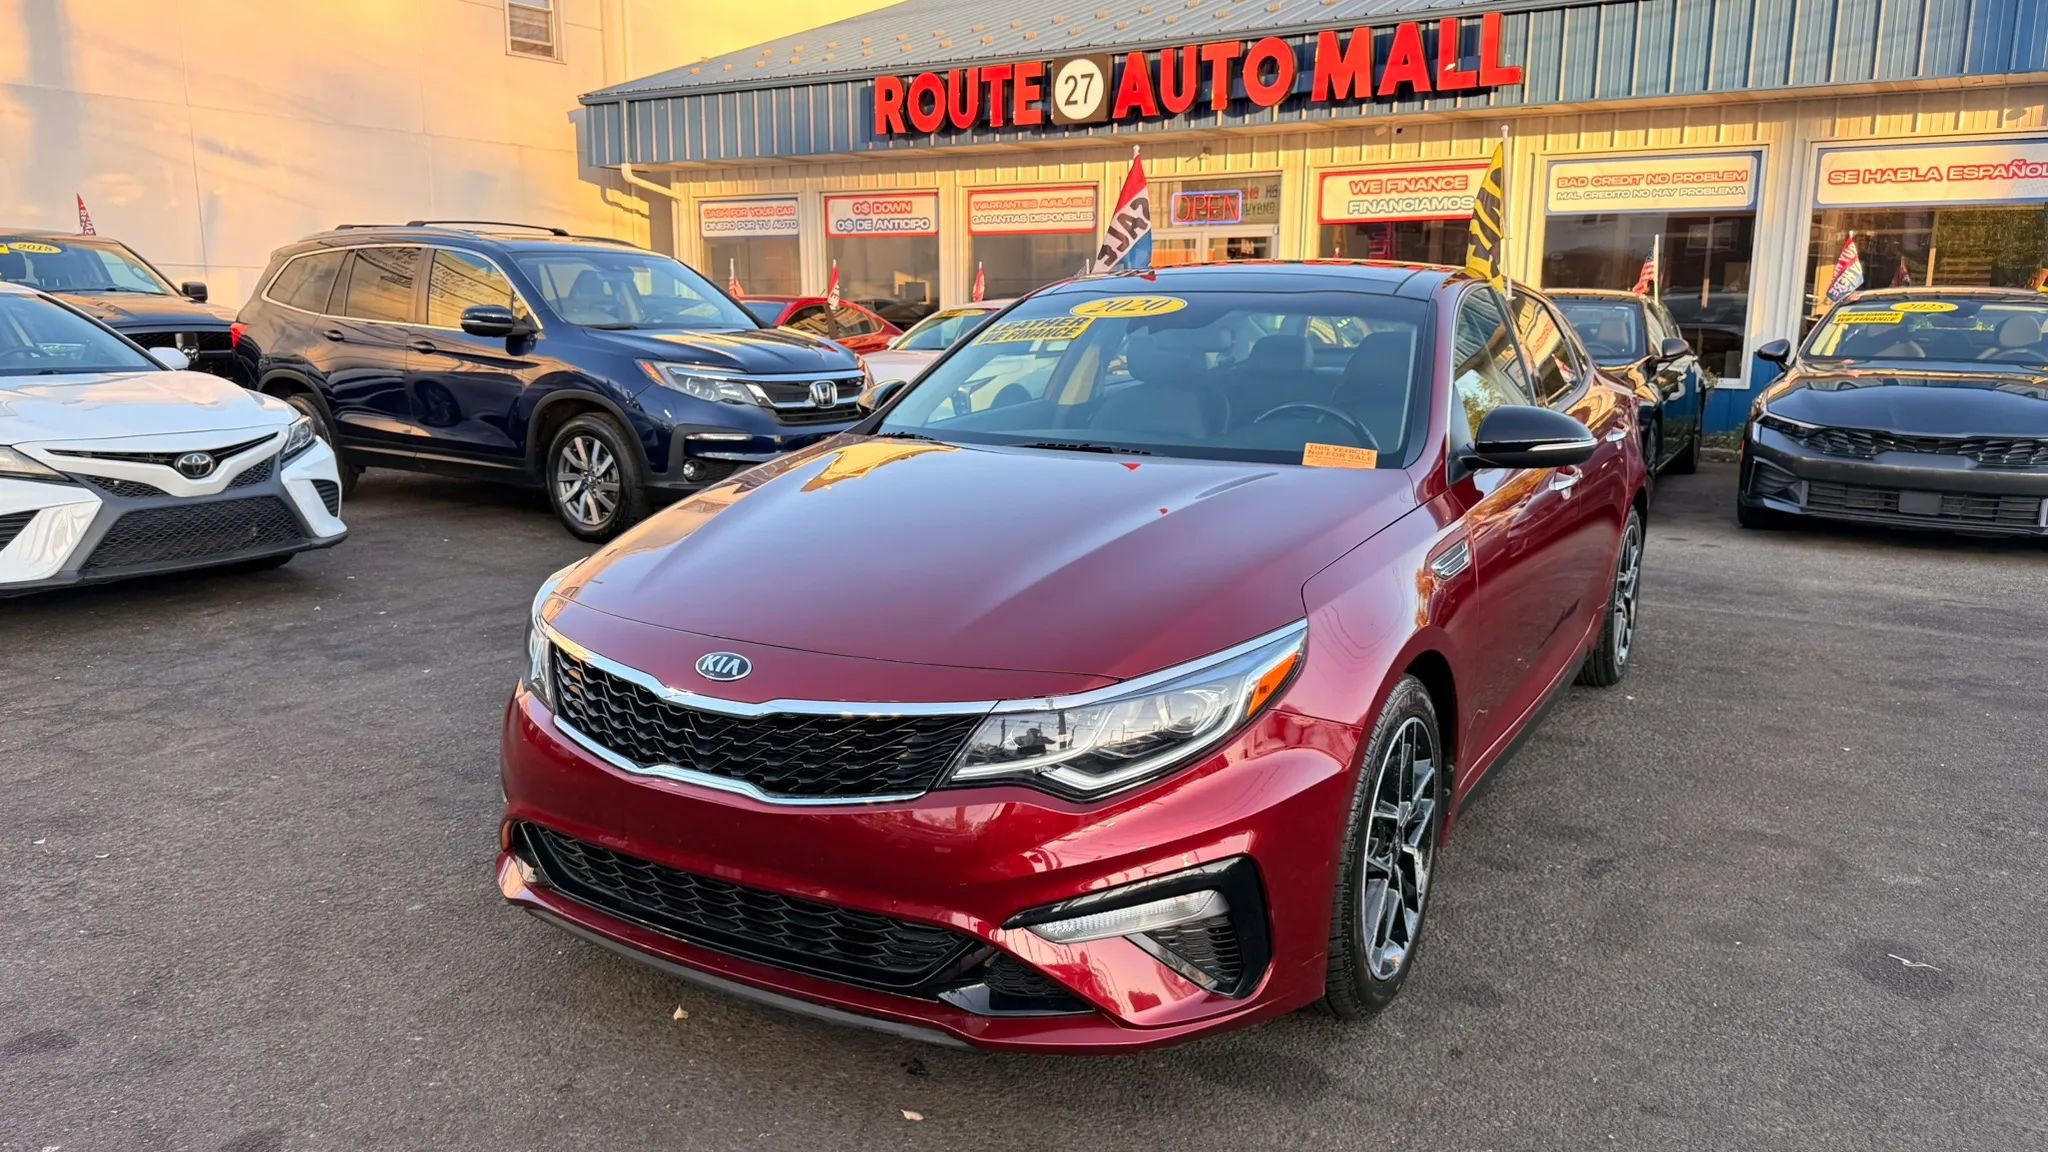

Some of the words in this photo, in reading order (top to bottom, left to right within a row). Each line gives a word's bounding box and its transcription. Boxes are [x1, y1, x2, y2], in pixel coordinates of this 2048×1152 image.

[874, 61, 1043, 135] ROUTE
[1064, 73, 1095, 107] 27
[1112, 36, 1295, 119] AUTO
[1311, 12, 1522, 102] MALL
[1557, 175, 1589, 188] BAD
[1591, 173, 1644, 187] CREDIT
[1646, 172, 1669, 185] NO
[1672, 170, 1748, 184] PROBLEM
[1828, 170, 1860, 185] SE
[1862, 167, 1943, 184] HABLA
[1350, 179, 1383, 195] WE
[1385, 175, 1468, 194] FINANCE
[1556, 190, 1582, 200] MAL
[1583, 189, 1631, 199] CREDITO
[1632, 188, 1650, 198] NO
[1653, 188, 1678, 197] HAY
[1679, 185, 1746, 196] PROBLEMA
[704, 208, 729, 218] CASH
[729, 208, 749, 217] FOR
[750, 207, 774, 217] YOUR
[776, 206, 796, 216] CAR
[872, 201, 912, 214] DOWN
[973, 198, 1037, 211] WARRANTIES
[1175, 194, 1240, 221] OPEN
[1347, 196, 1475, 215] FINANCIAMOS
[704, 221, 736, 231] DINERO
[737, 220, 756, 230] POR
[757, 220, 771, 229] TU
[772, 219, 798, 229] AUTO
[855, 219, 874, 232] DE
[874, 217, 931, 231] ANTICIPO
[972, 213, 1028, 224] GARANTIAS
[1028, 211, 1094, 223] DISPONIBLES
[1084, 299, 1172, 313] 2020
[990, 317, 1087, 332] LEATHER
[1003, 326, 1081, 340] FINANCE
[701, 654, 741, 676] KIA
